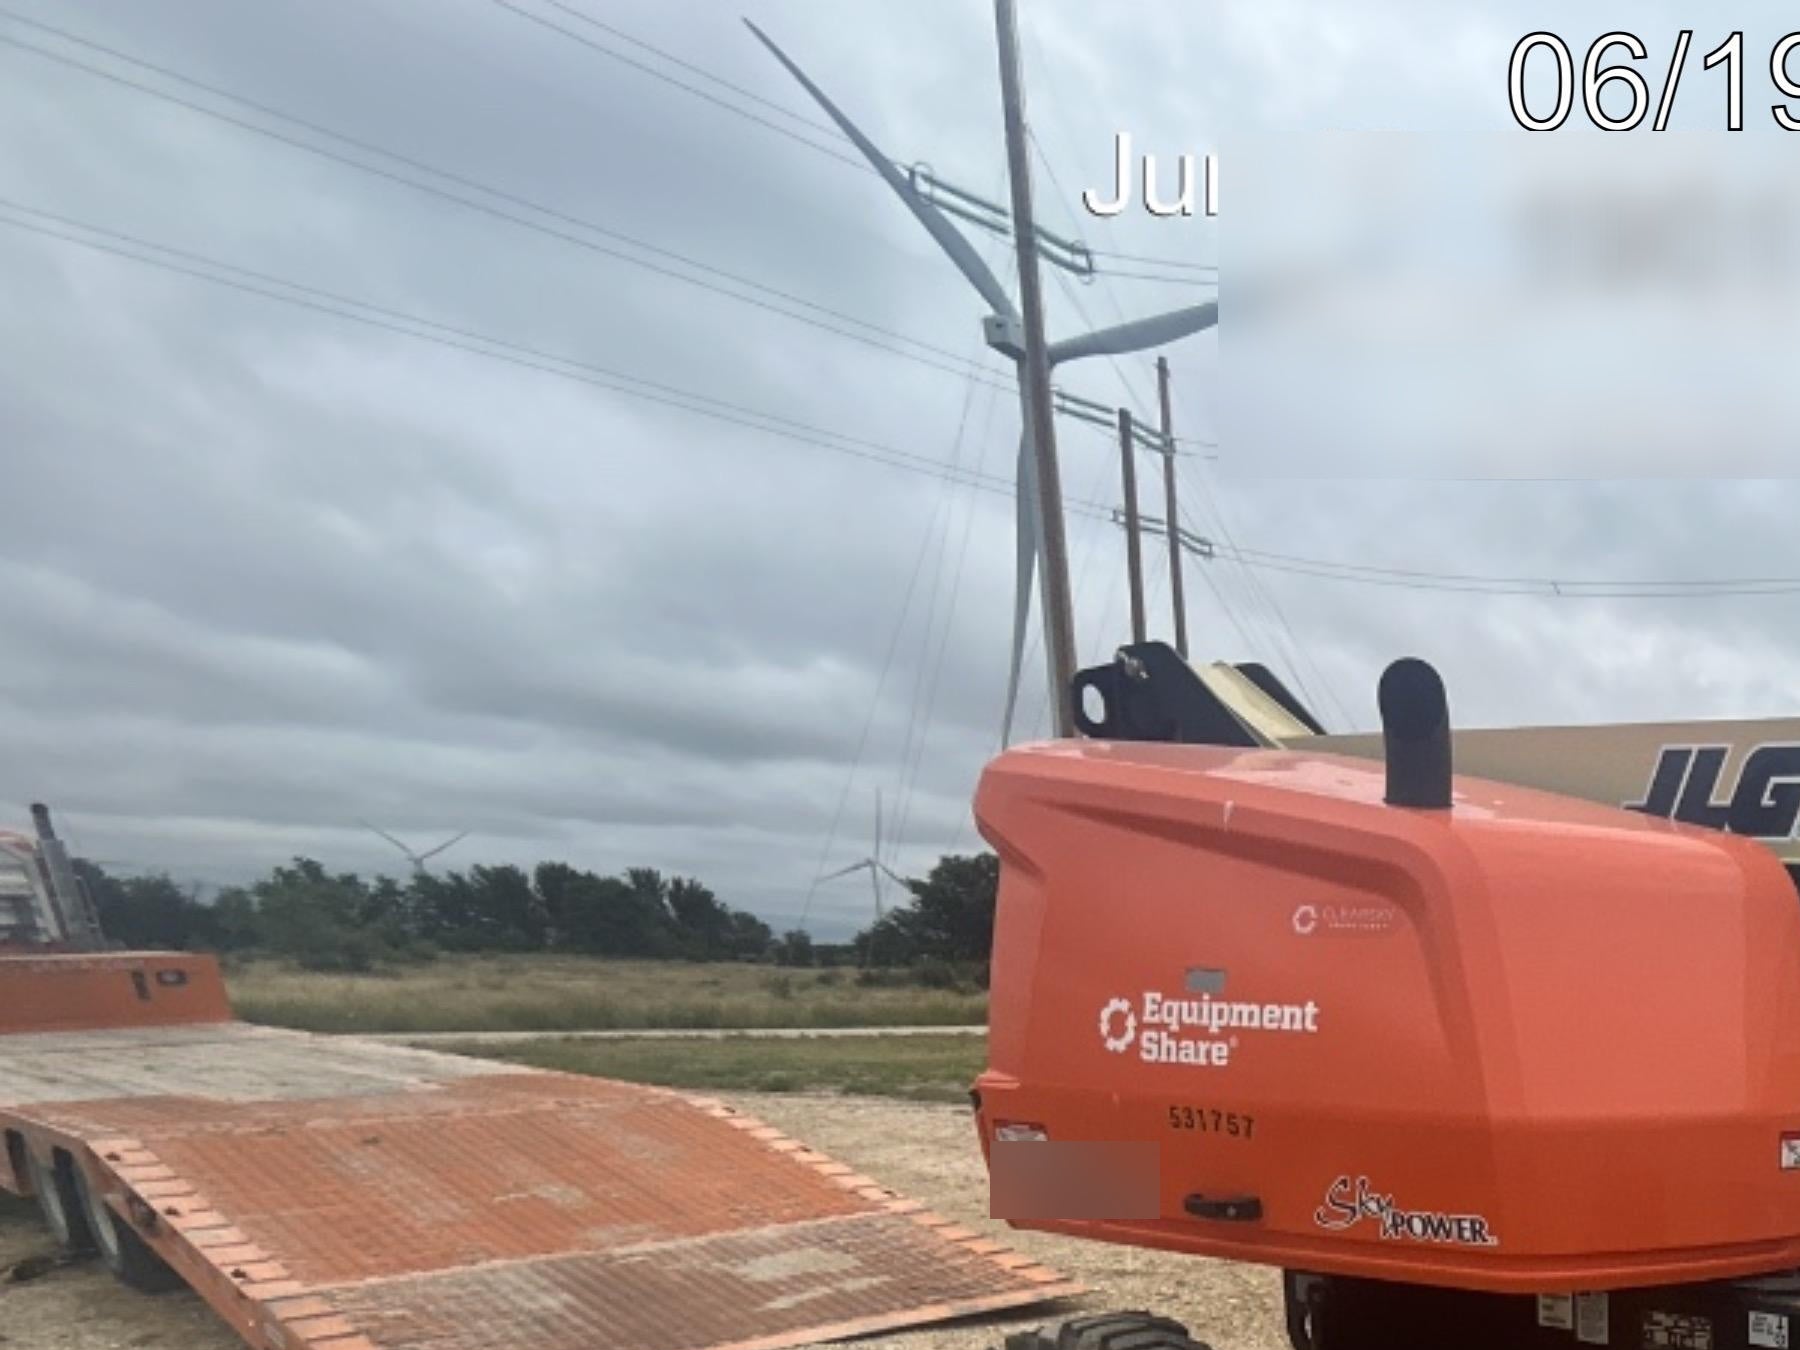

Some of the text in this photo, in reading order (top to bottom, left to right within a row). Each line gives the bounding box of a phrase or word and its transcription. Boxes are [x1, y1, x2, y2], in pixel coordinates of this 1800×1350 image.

[1142, 991, 1320, 1034] Equipment
[1140, 1030, 1229, 1067] Share
[1168, 1105, 1255, 1138] 531757
